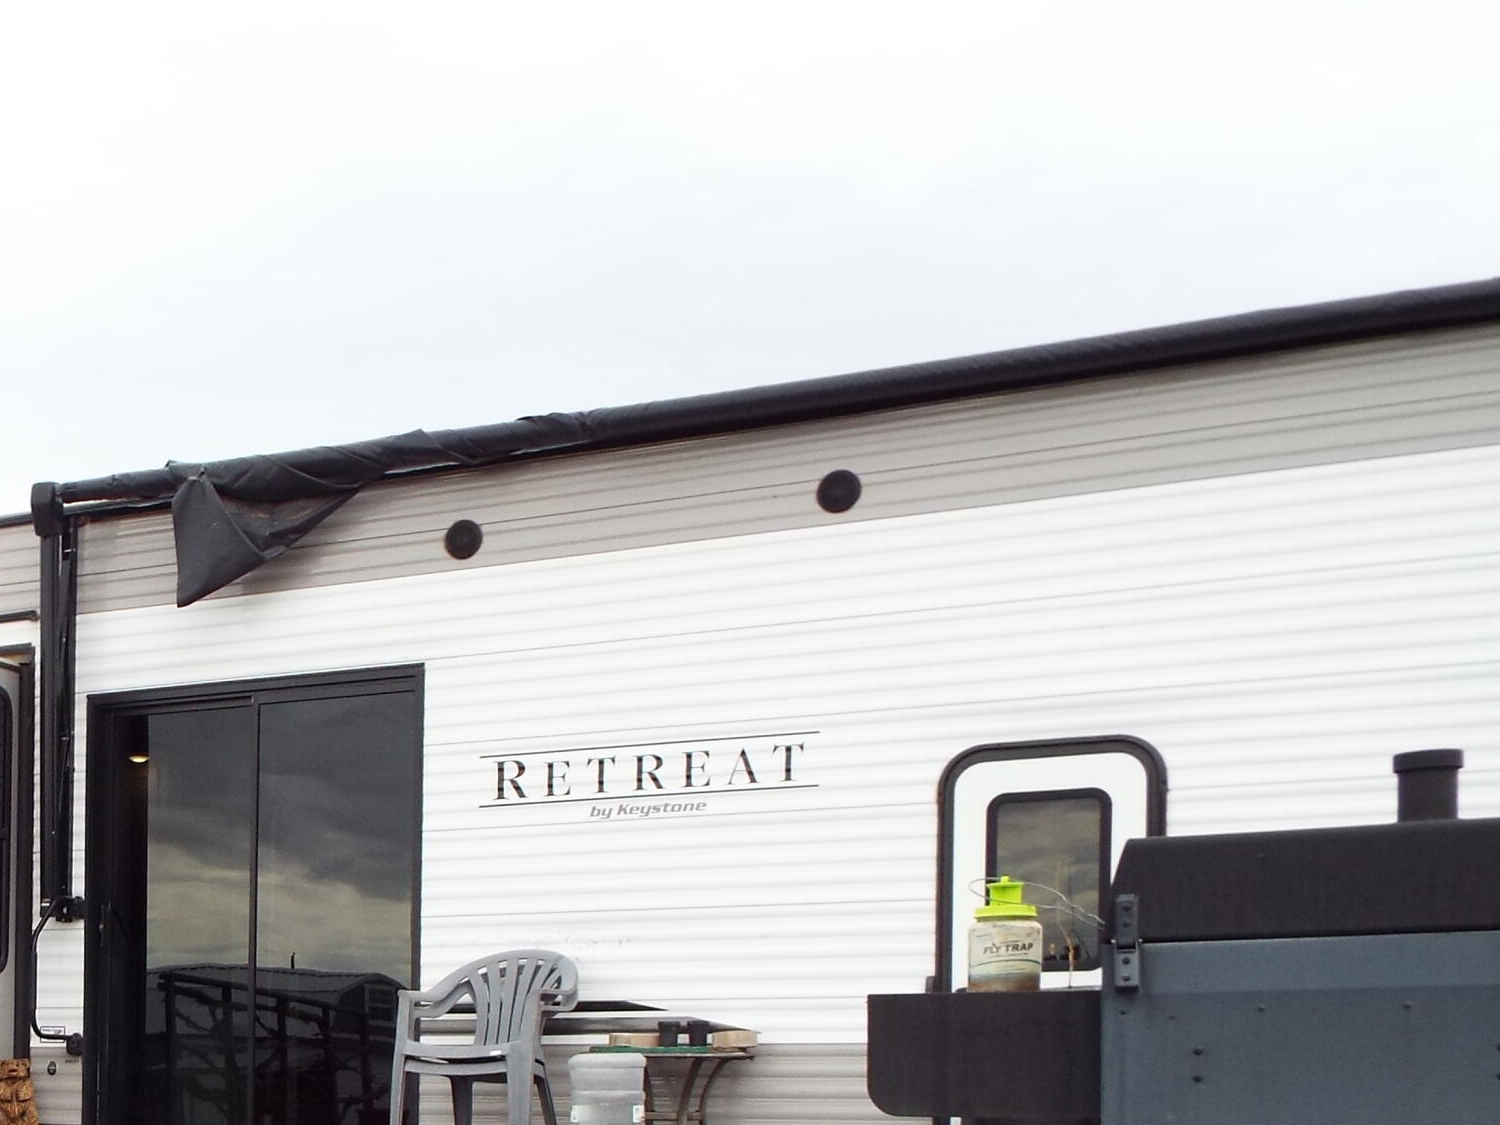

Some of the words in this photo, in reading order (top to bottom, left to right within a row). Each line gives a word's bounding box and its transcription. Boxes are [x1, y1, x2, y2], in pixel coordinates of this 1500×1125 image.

[493, 742, 805, 800] RETREAT
[589, 804, 612, 819] by
[617, 802, 708, 818] Keystone
[983, 942, 1002, 955] FLY
[1004, 942, 1033, 952] TRAP
